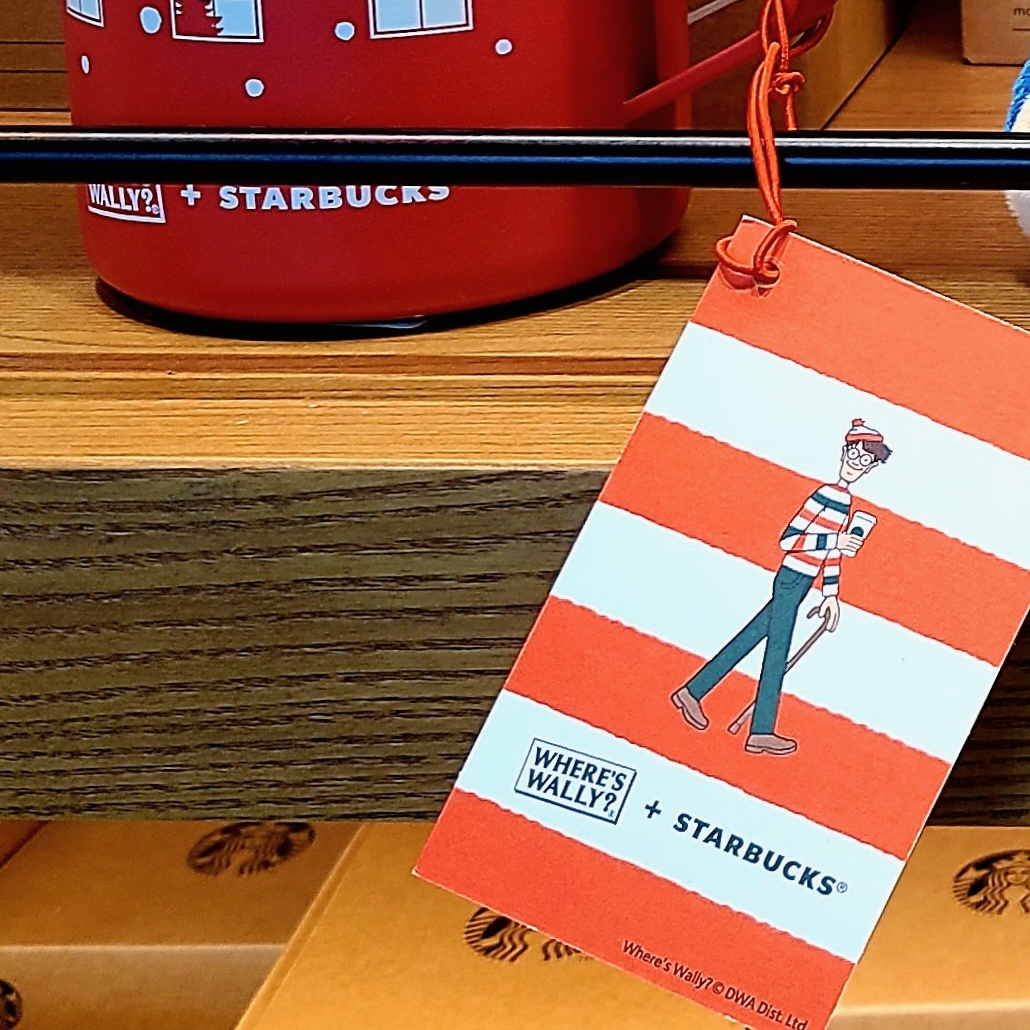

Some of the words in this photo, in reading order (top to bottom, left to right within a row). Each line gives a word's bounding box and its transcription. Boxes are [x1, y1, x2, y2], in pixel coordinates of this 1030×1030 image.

[88, 183, 154, 213] WALLY?
[180, 183, 201, 206] +
[533, 746, 628, 792] WHERE'S
[526, 769, 617, 813] WALLY?
[644, 799, 662, 819] +
[623, 939, 672, 973] Where's
[673, 962, 714, 990] Wally?
[724, 986, 756, 1012] DWA
[756, 1000, 783, 1024] Dist.
